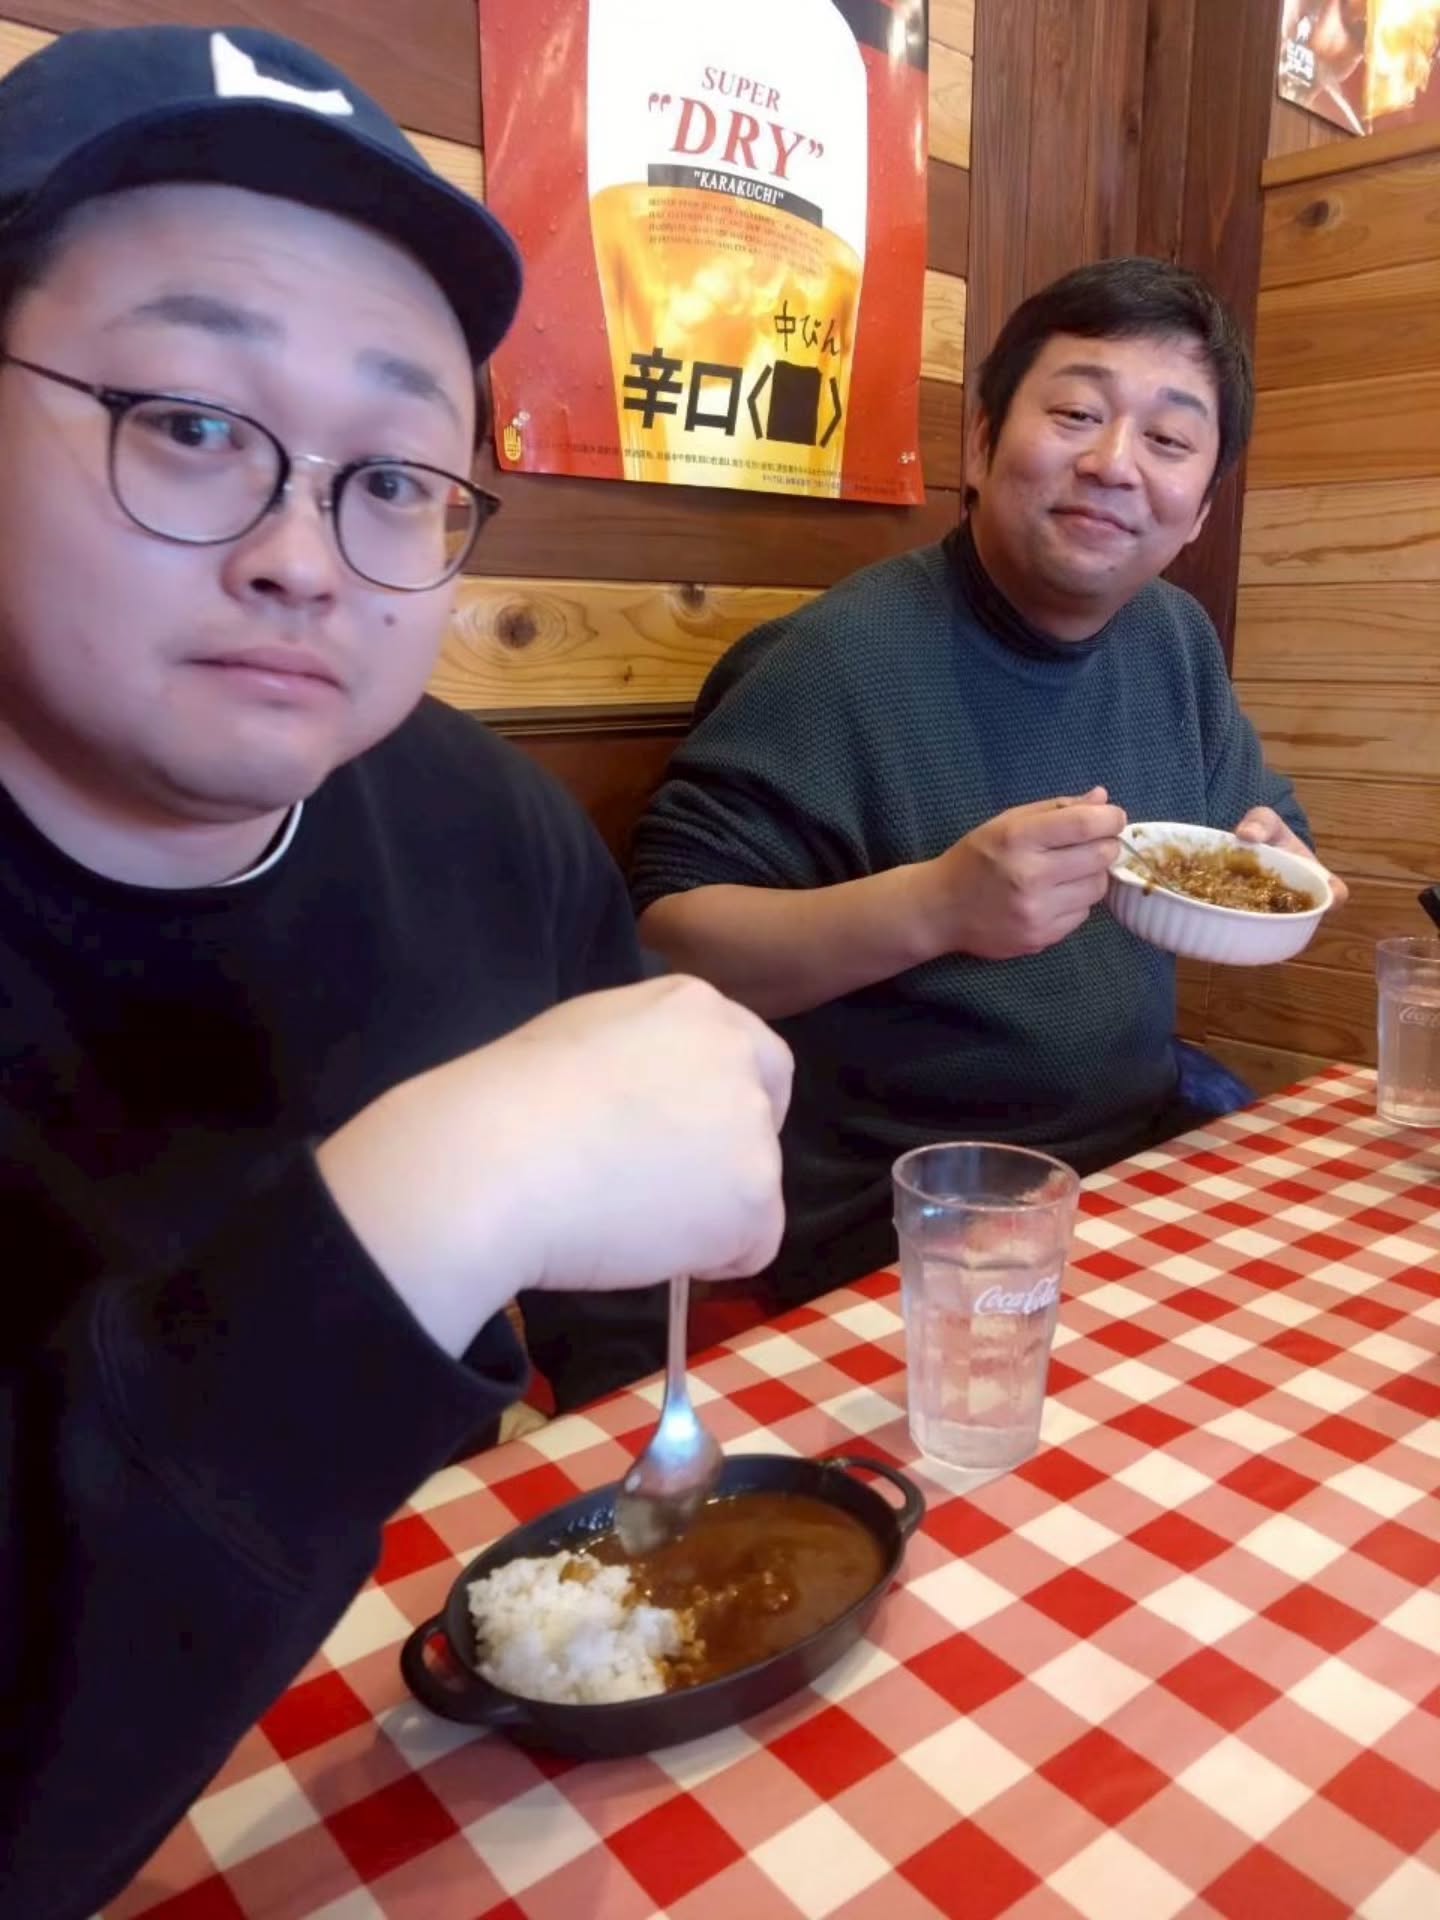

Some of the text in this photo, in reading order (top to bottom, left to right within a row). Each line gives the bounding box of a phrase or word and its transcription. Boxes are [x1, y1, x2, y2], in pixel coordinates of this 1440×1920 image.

[700, 66, 781, 111] SUPER
[693, 169, 785, 206] "KARAKUCHI"
[774, 299, 841, 356] 中びん
